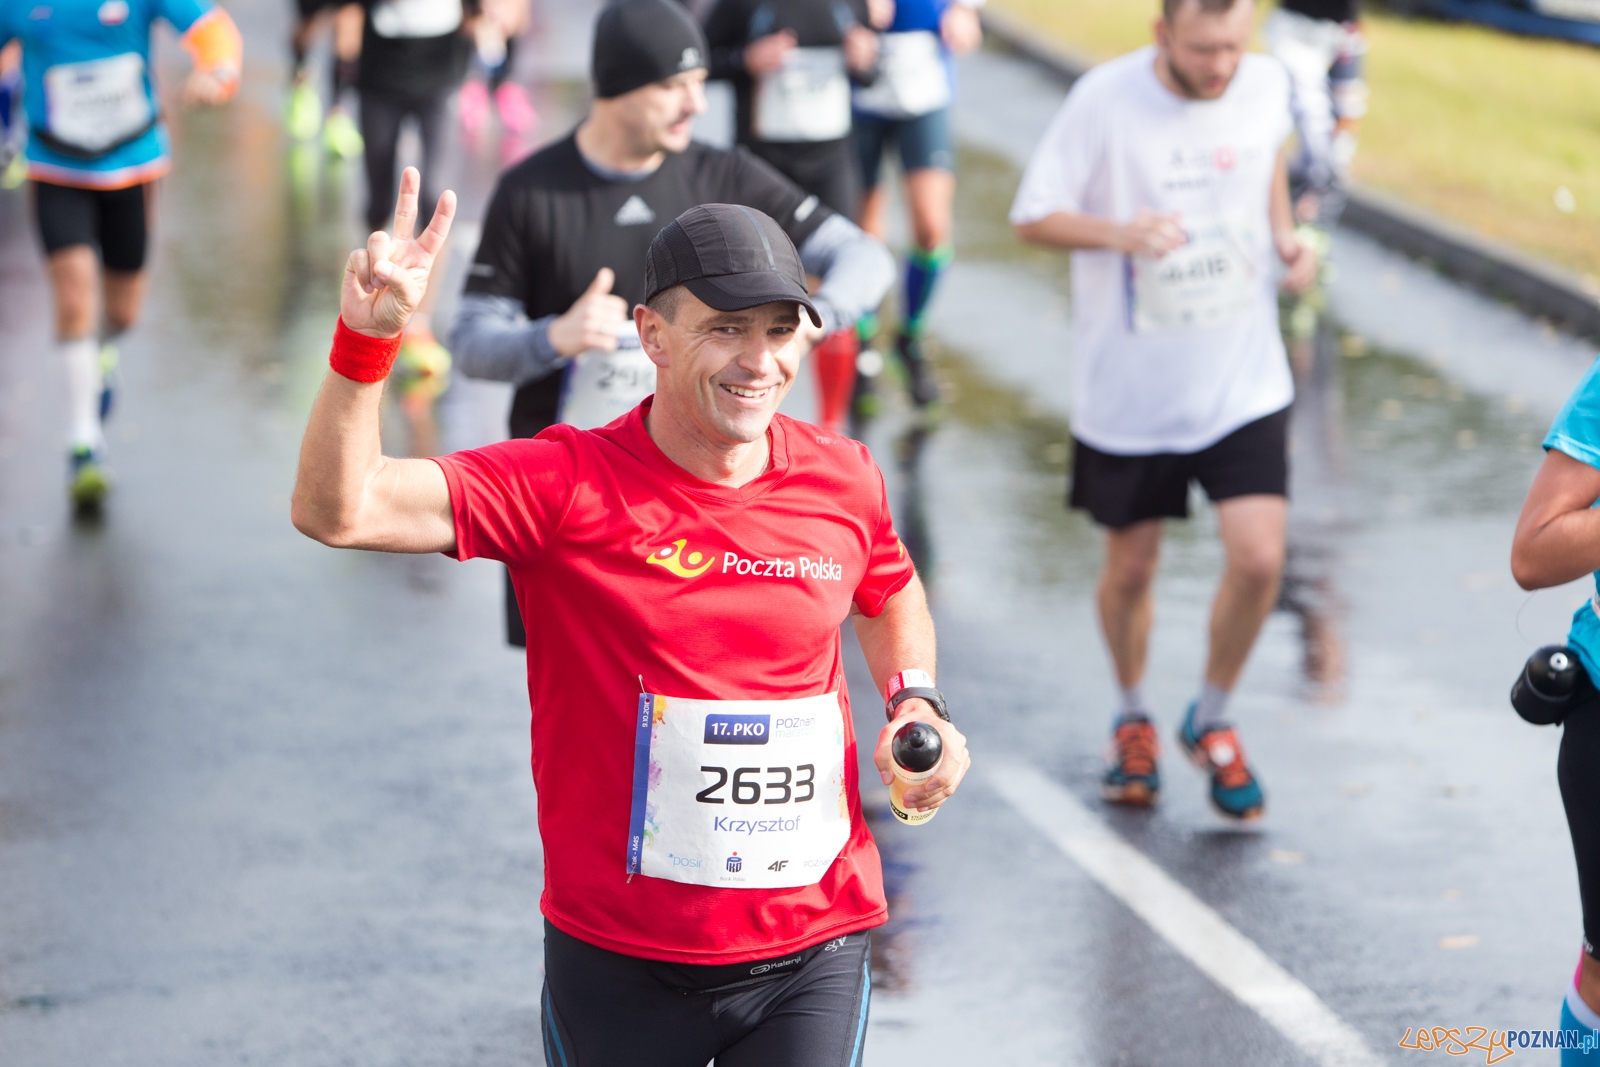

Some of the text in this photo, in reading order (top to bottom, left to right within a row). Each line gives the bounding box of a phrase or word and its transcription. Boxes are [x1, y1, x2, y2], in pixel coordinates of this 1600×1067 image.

[722, 551, 842, 581] Poczta Polska
[711, 722, 765, 736] 17. PKO
[775, 726, 816, 739] maraton
[695, 763, 815, 805] 2633
[714, 816, 801, 835] Krzysztof
[771, 956, 802, 970] Kalenji
